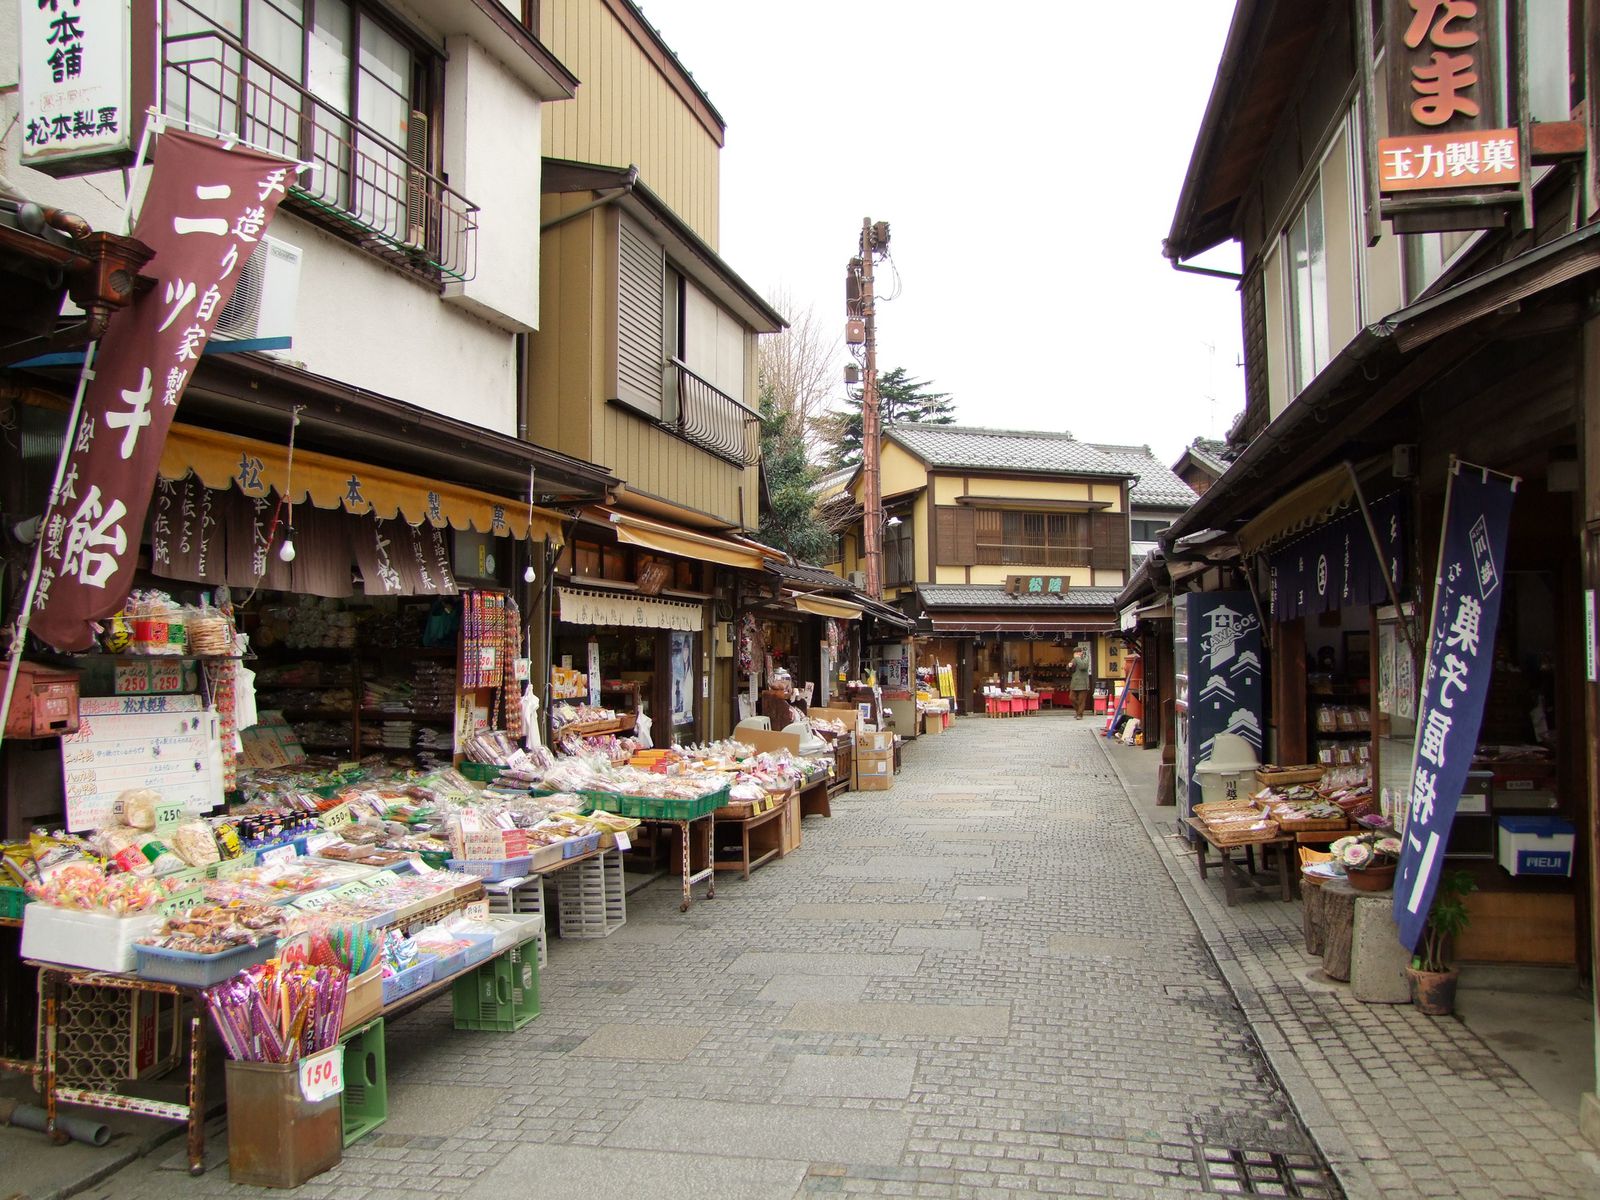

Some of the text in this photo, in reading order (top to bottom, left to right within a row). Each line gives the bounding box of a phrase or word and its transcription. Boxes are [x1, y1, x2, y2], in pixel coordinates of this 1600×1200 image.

[38, 0, 84, 83] 本舗
[25, 107, 118, 146] 松本製菓
[1383, 139, 1516, 181] 玉力製菓
[162, 168, 288, 406] 手造り自家製
[32, 410, 95, 610] 松本製菓
[1200, 612, 1257, 653] KAWAGOE
[1526, 856, 1562, 869] MEIJI
